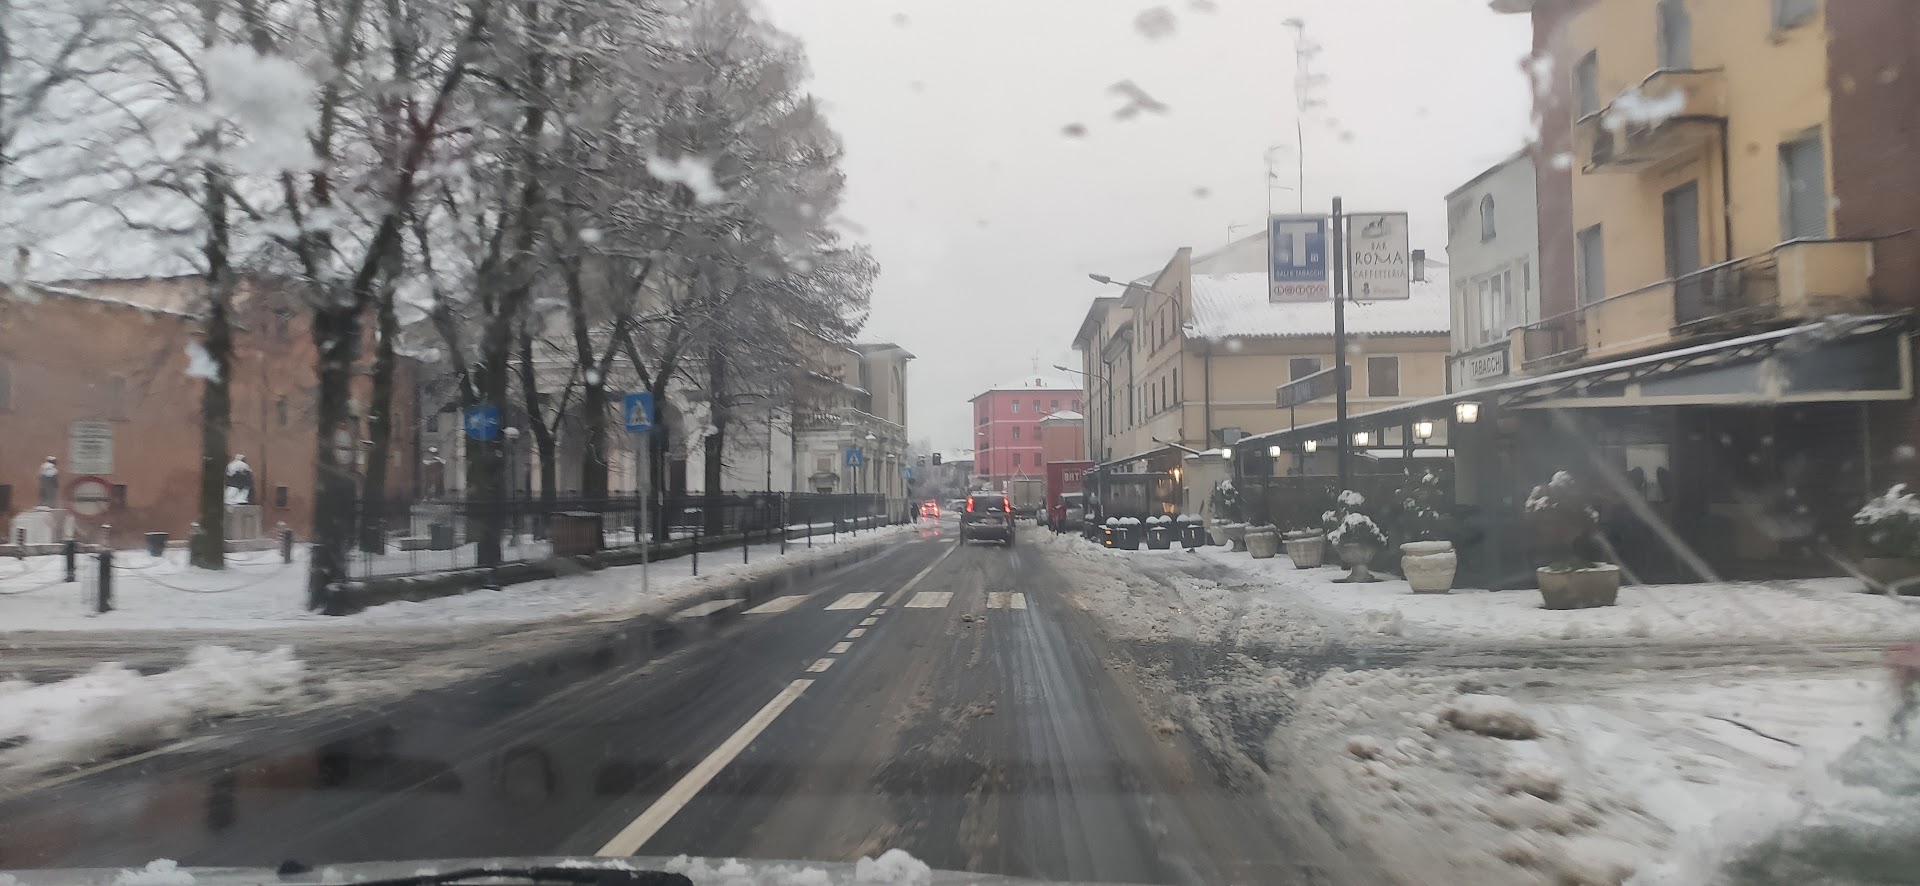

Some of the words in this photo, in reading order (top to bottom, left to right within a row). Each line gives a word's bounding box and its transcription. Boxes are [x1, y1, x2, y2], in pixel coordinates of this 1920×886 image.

[1280, 222, 1318, 267] T
[1355, 250, 1404, 266] ROMA
[1471, 354, 1502, 377] TABACCHI
[1064, 472, 1080, 481] BRT
